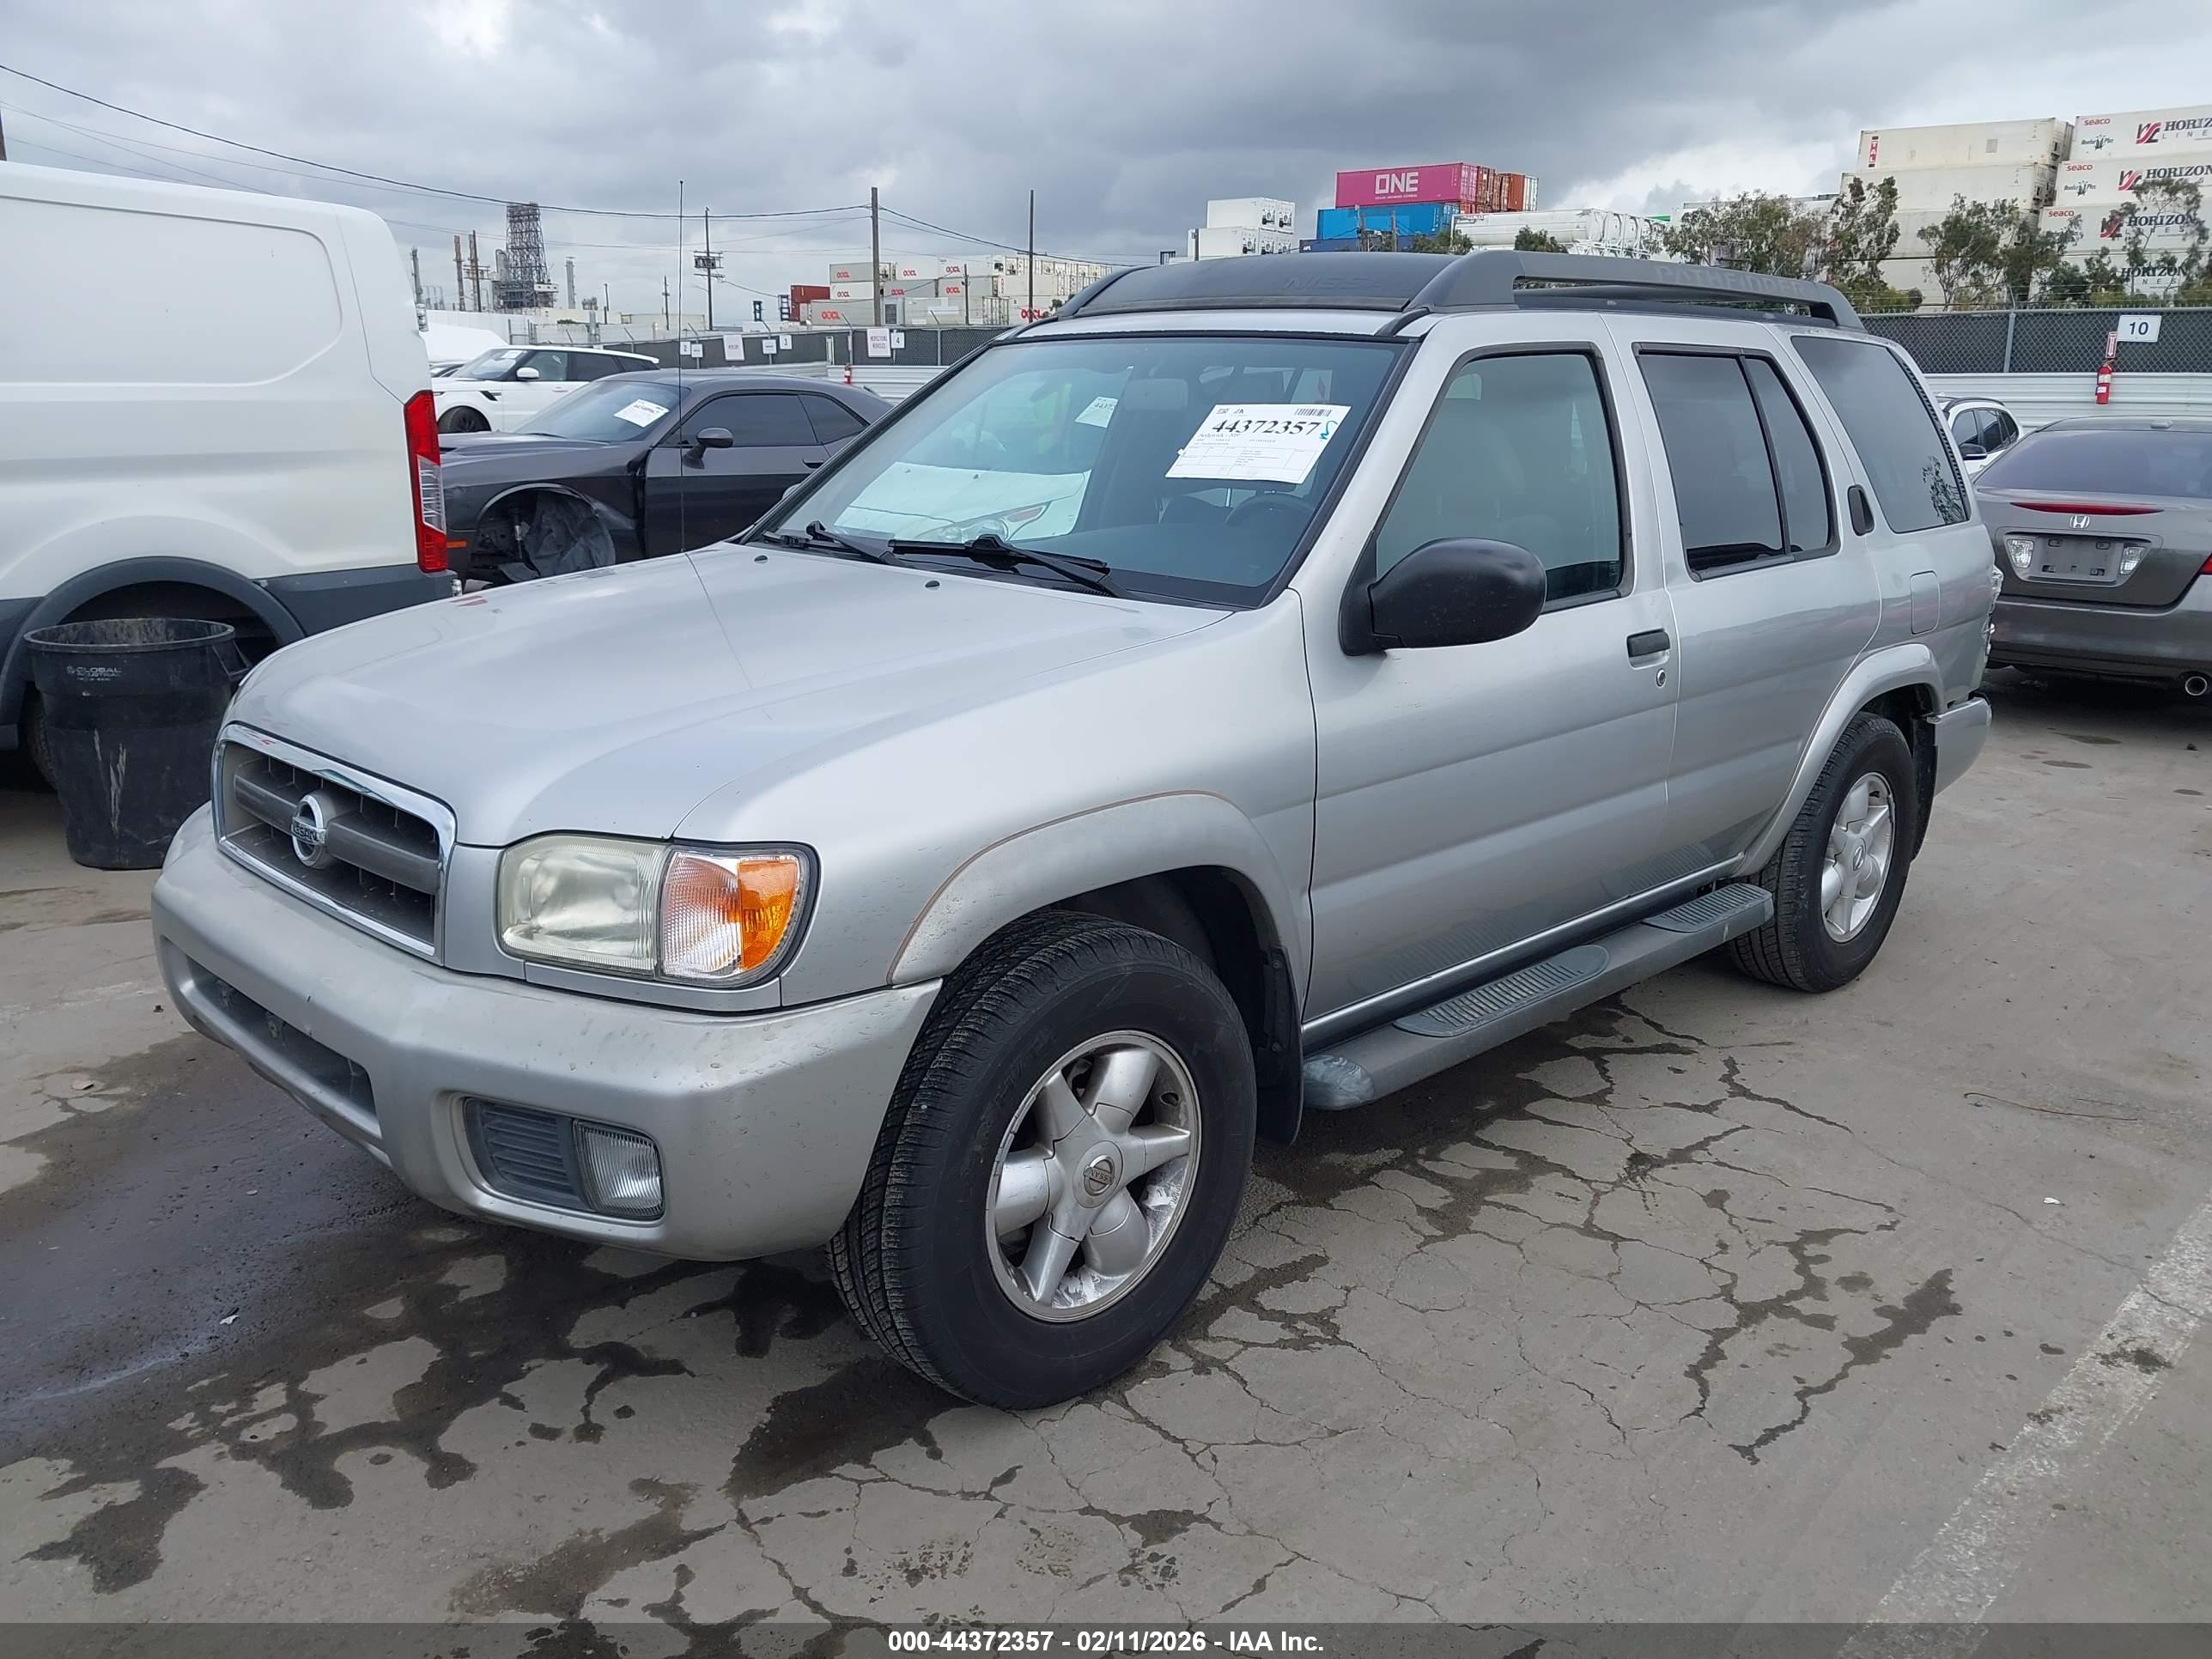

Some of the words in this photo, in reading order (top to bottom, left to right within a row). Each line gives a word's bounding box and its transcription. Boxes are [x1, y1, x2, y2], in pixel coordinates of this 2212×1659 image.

[2084, 118, 2111, 126] seaco
[2164, 117, 2212, 131] HORIZ
[2162, 130, 2209, 139] LINE
[2146, 165, 2212, 179] HORIZON
[1375, 172, 1419, 194] ONE
[2047, 209, 2075, 218] seaco
[2127, 215, 2197, 227] HORIZON
[2125, 226, 2185, 235] LNES
[2121, 266, 2189, 278] HORIZON
[1656, 265, 1805, 295] PATHFINDER
[2130, 321, 2149, 336] 10
[1212, 419, 1323, 435] 44372357
